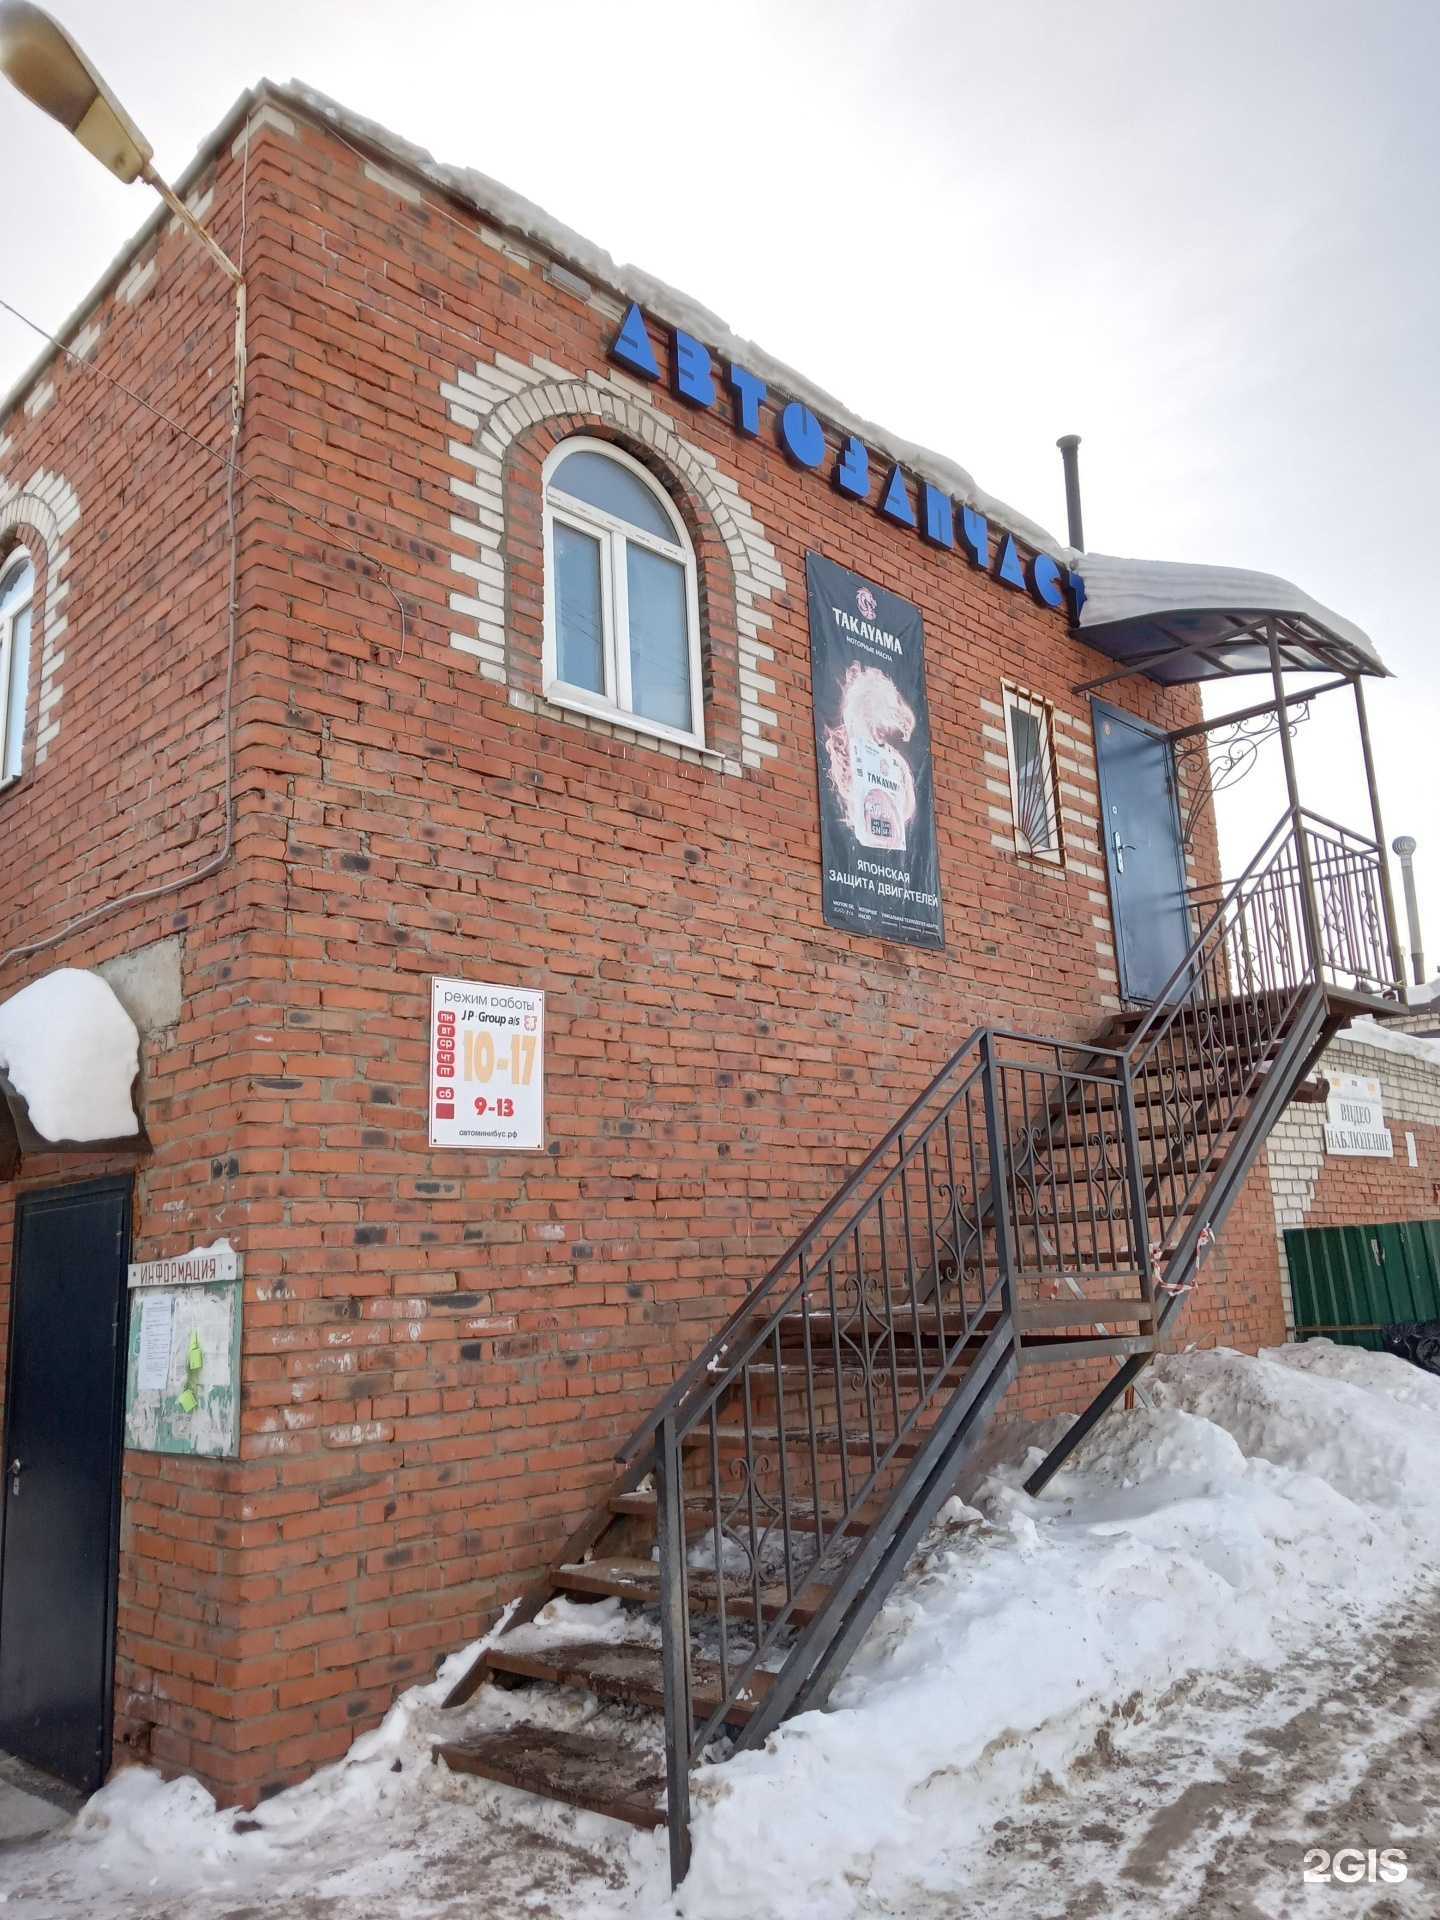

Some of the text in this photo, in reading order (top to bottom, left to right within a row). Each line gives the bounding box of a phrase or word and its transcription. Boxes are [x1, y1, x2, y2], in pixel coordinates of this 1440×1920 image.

[831, 607, 903, 655] TAKAYAMA
[857, 859, 910, 883] ЯПОНСКАЯ
[829, 869, 938, 907] ЗАЩИТА ДВИГАТЕЛЕЙ
[444, 991, 535, 1011] режим работы
[478, 1011, 506, 1027] Group
[464, 1030, 537, 1085] 10-17
[440, 1089, 452, 1098] сб
[474, 1097, 514, 1117] 9-13
[1340, 1103, 1371, 1125] ВИДЕО
[459, 1129, 518, 1138] автоминибус.рф
[1327, 1130, 1390, 1151] НАБЛЮДЕНИЕ
[140, 1258, 216, 1284] ИНФОРМАЦИЯ
